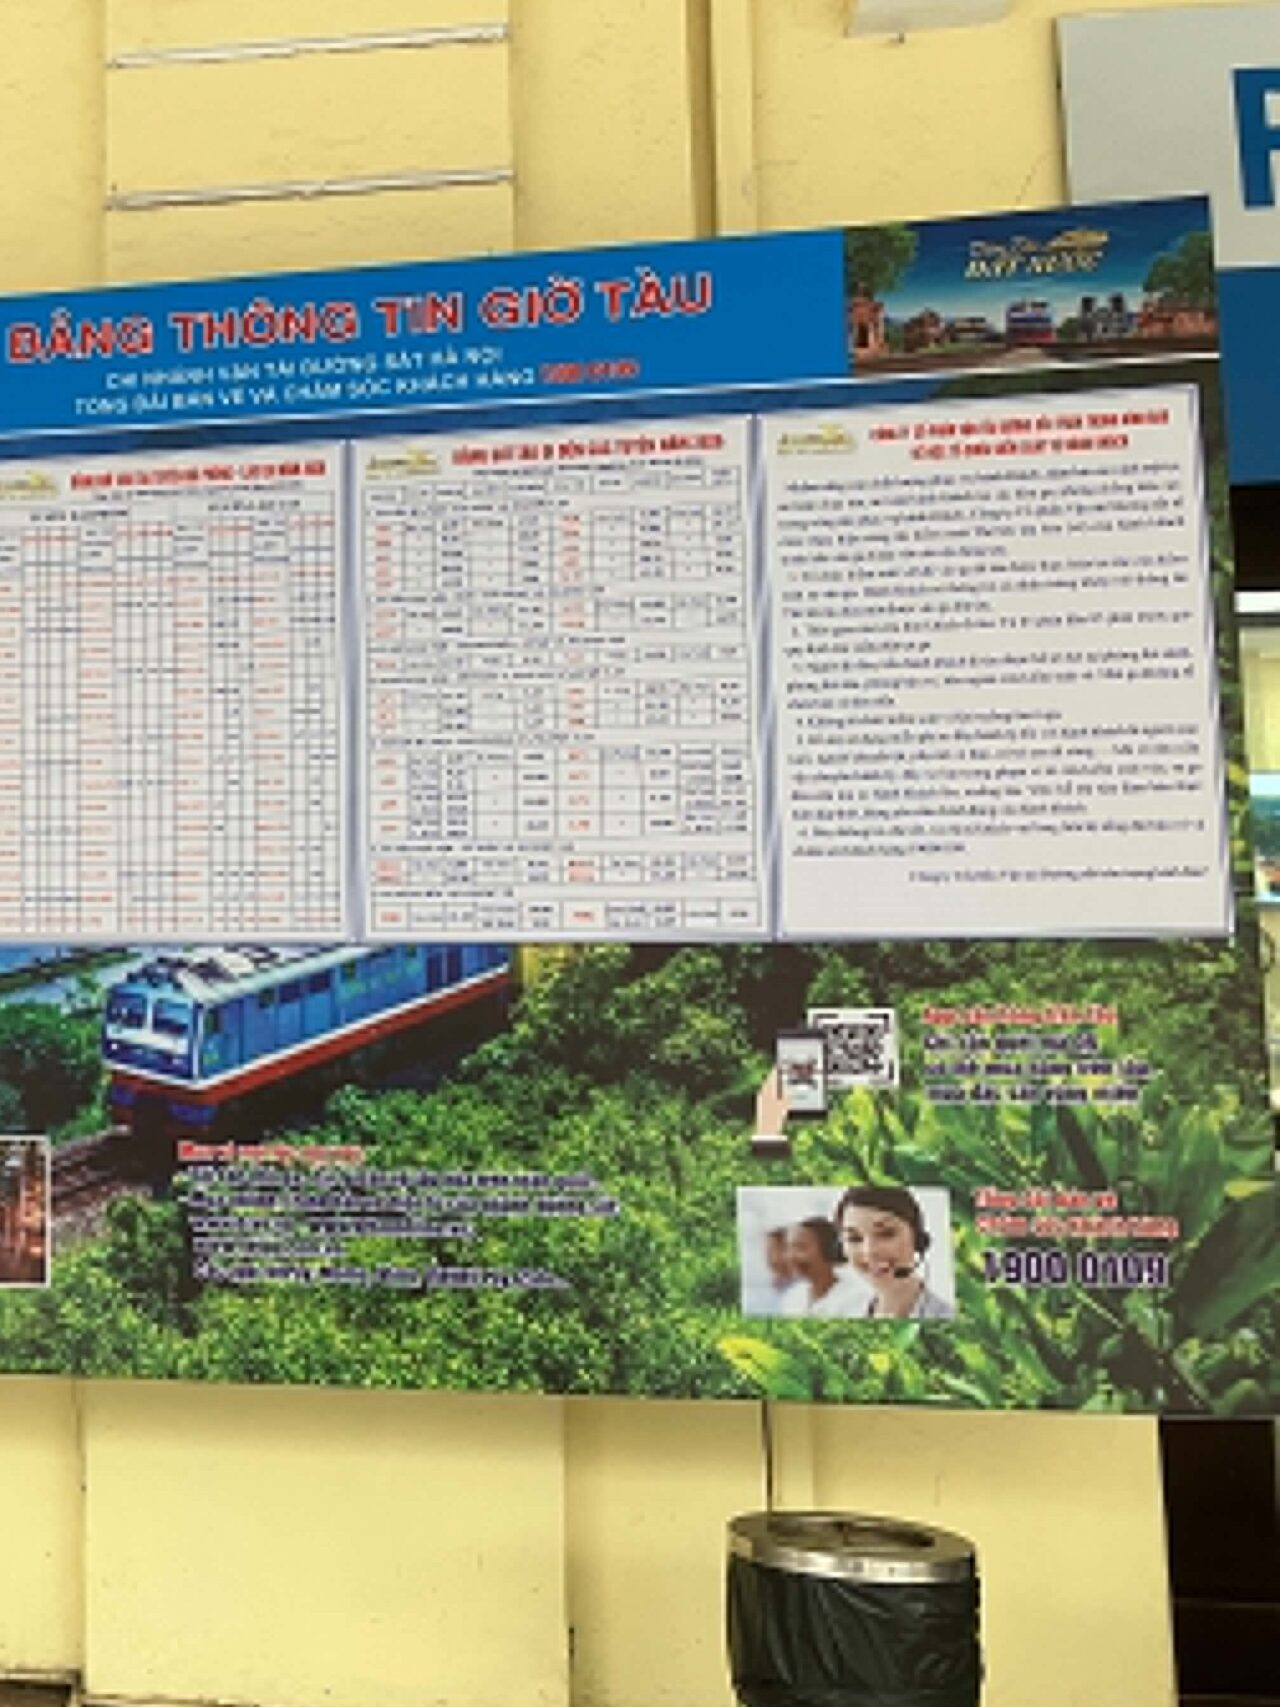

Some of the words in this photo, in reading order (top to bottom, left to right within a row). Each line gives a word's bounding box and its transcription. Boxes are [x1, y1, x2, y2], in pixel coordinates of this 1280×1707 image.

[169, 298, 362, 353] THÔNG
[373, 291, 464, 339] TIN
[477, 272, 585, 330] GIỜ
[983, 1247, 1069, 1288] 1900
